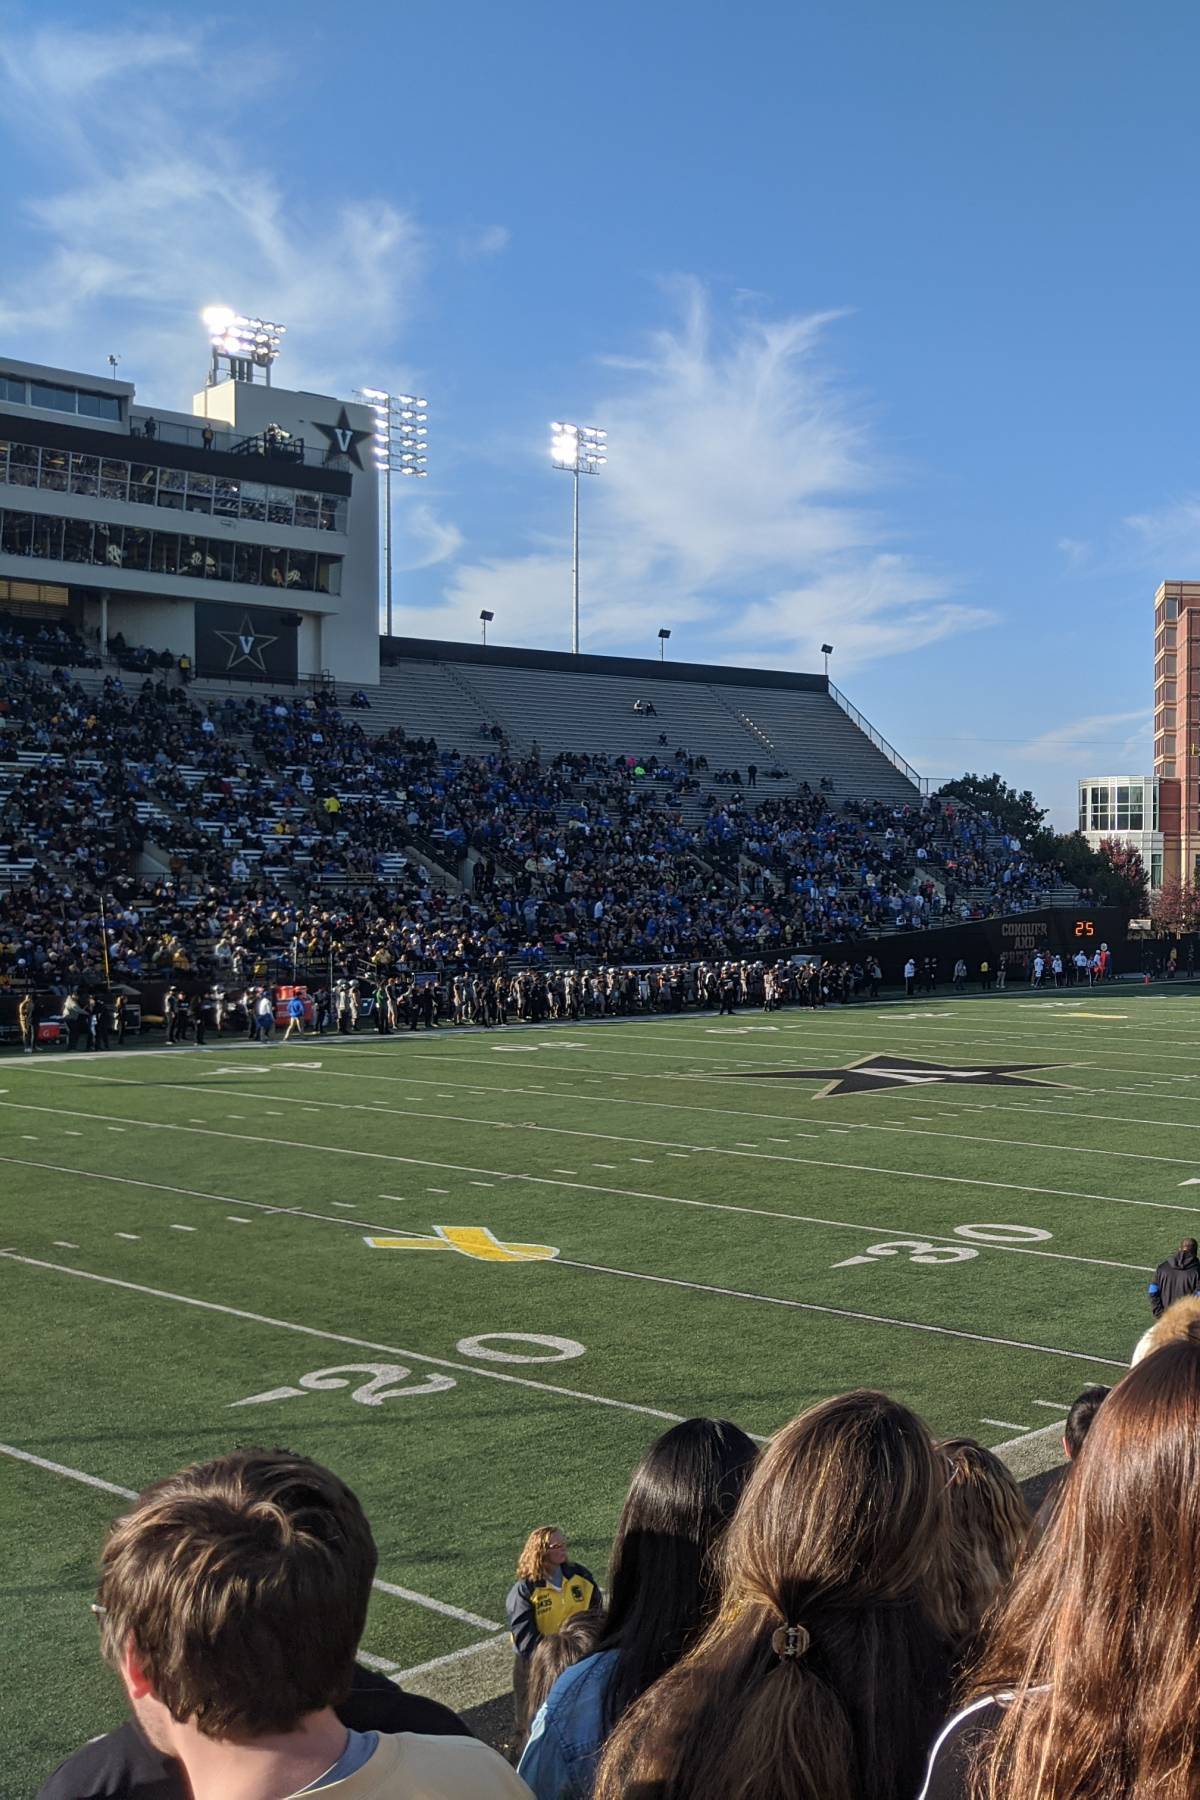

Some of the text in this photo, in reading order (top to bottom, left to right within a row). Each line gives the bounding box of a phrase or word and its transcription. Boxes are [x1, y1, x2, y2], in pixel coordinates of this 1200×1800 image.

[334, 428, 353, 452] V
[239, 635, 255, 654] V
[1001, 922, 1048, 937] CONQUER
[1075, 922, 1094, 936] 25
[1014, 935, 1036, 949] AND
[866, 1223, 1054, 1264] 30
[299, 1332, 587, 1406] 20
